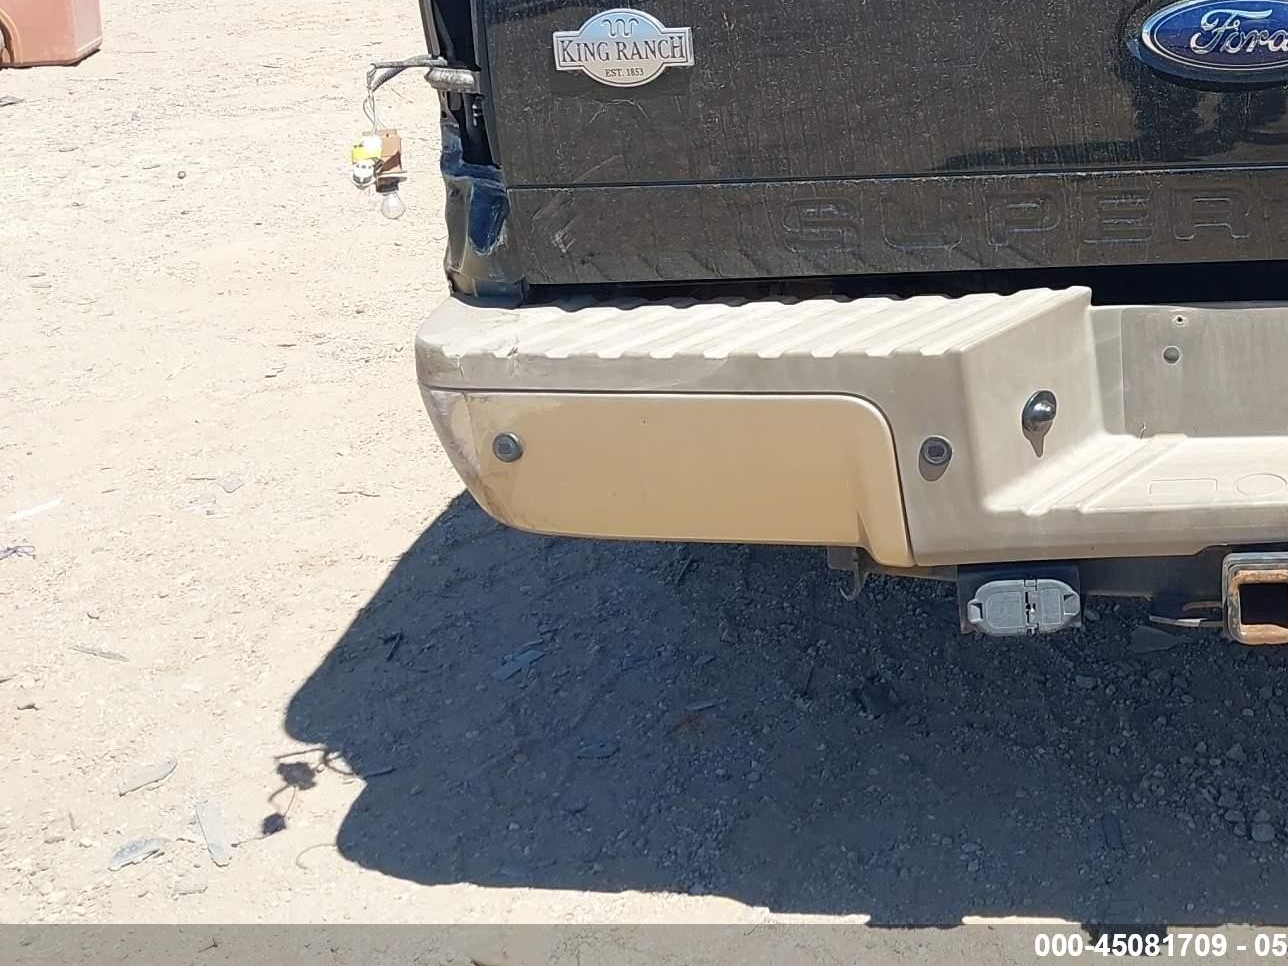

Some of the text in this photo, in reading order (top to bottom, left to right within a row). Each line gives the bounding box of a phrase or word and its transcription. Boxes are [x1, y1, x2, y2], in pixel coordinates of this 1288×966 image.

[559, 35, 686, 63] KING RANCH
[605, 67, 644, 78] EST. 1853
[780, 186, 1252, 253] SUPER
